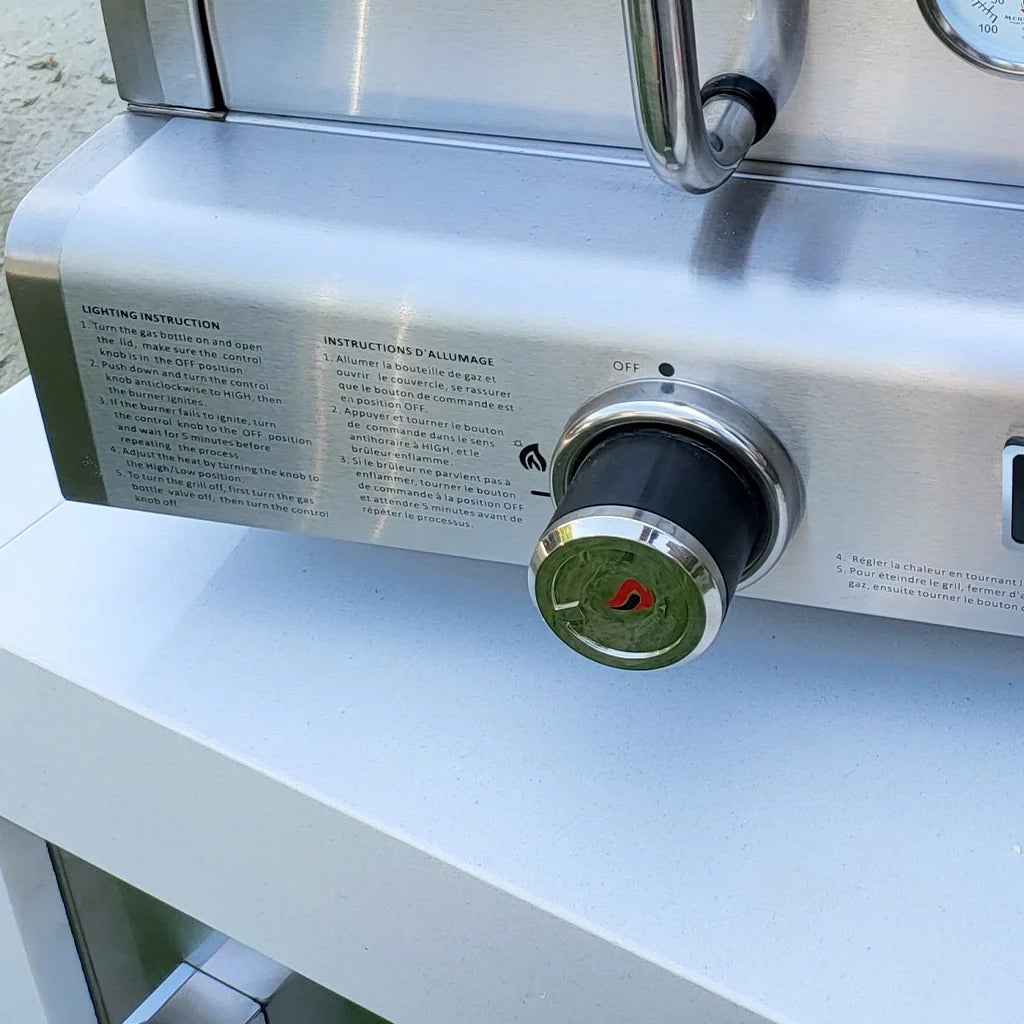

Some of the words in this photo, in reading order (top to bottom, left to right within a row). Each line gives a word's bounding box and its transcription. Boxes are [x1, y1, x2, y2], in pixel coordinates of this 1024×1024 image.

[978, 24, 998, 34] 100
[82, 305, 137, 319] LIGHTING
[141, 313, 220, 330] INSTRUCTION
[92, 321, 116, 332] Turn
[120, 326, 137, 335] the
[160, 331, 193, 342] bottle
[196, 337, 209, 345] on
[212, 339, 232, 347] and
[235, 342, 262, 351] open
[97, 336, 114, 345] the
[120, 338, 137, 349] lid,
[143, 342, 170, 352] make
[174, 347, 196, 355] sure
[199, 349, 217, 358] the
[223, 353, 262, 364] control
[100, 348, 126, 358] knob
[140, 354, 149, 362] in
[155, 356, 173, 365] the
[175, 359, 196, 367] OFF
[199, 363, 243, 374] position
[324, 336, 412, 355] INSTRUCTIONS
[416, 348, 495, 366] D'ALLUMAGE
[102, 361, 127, 371] Push
[130, 365, 159, 375] down
[162, 370, 181, 378] and
[184, 373, 207, 382] turn
[210, 376, 227, 385] the
[231, 379, 269, 390] control
[336, 355, 379, 367] Allumer
[383, 361, 392, 369] la
[395, 363, 445, 376] bouteille
[448, 370, 461, 378] de
[465, 373, 482, 382] gaz
[613, 360, 640, 373] OFF
[337, 369, 370, 379] ouvrir
[378, 373, 388, 381] le
[391, 376, 448, 392] couvercle,
[466, 387, 511, 398] rassurer
[339, 382, 359, 391] que
[361, 384, 371, 393] le
[375, 385, 414, 398] bouton
[417, 392, 430, 400] de
[433, 395, 495, 409] commande
[498, 404, 514, 412] est
[357, 398, 401, 409] position
[345, 407, 390, 420] Appuyer
[393, 414, 404, 422] et
[407, 416, 448, 428] tourner
[452, 421, 461, 430] le
[464, 423, 504, 436] bouton
[366, 424, 426, 438] commande
[430, 432, 455, 442] dans
[459, 435, 467, 443] le
[471, 439, 495, 447] sens
[349, 434, 410, 448] antihoraire
[414, 441, 419, 449] à
[422, 443, 454, 455] HIGH,
[471, 449, 479, 457] le
[352, 445, 391, 457] brûleur
[352, 456, 361, 465] Si
[364, 459, 373, 467] le
[377, 461, 416, 472] brûleur
[435, 471, 481, 482] parvient
[484, 477, 502, 485] pas
[505, 478, 511, 486] à
[356, 471, 418, 486] enflammer,
[420, 479, 461, 491] tourner
[465, 485, 474, 493] le
[477, 486, 516, 499] bouton
[358, 482, 371, 490] de
[374, 486, 433, 498] commande
[445, 494, 454, 502] la
[457, 497, 500, 508] position
[504, 502, 525, 511] OFF
[849, 567, 876, 577] Pour
[879, 572, 927, 585] éteindre
[930, 579, 940, 587] le
[942, 581, 964, 592] gril,
[967, 584, 1007, 597] fermer
[852, 555, 888, 567] Régler
[891, 560, 900, 569] la
[903, 563, 946, 575] chaleur
[966, 572, 1017, 586] tournant
[848, 580, 870, 590] gaz,
[873, 584, 915, 595] ensuite
[917, 590, 961, 603] tourner
[964, 596, 974, 604] le
[977, 597, 1018, 611] bouton
